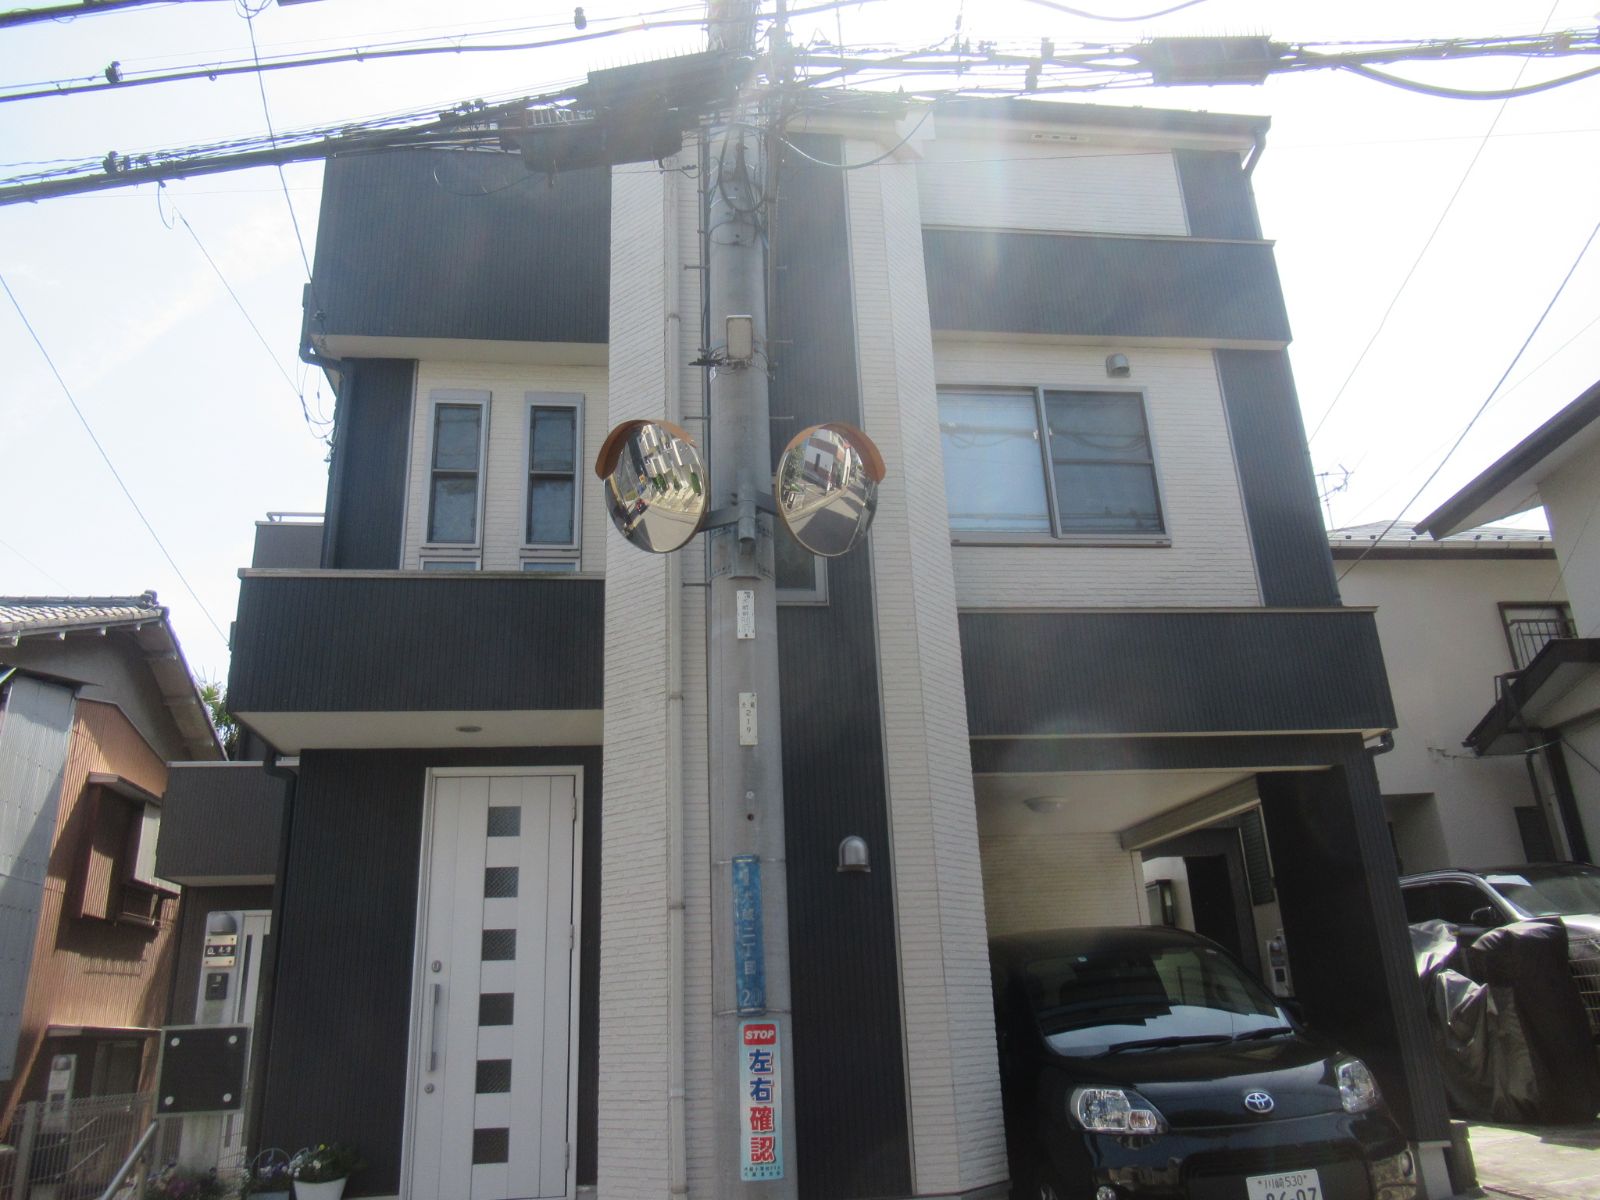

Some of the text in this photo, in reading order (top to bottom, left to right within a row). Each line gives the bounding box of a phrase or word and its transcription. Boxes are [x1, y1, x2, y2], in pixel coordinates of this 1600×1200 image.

[745, 1029, 775, 1040] STOP
[749, 1048, 775, 1163] 左右確認
